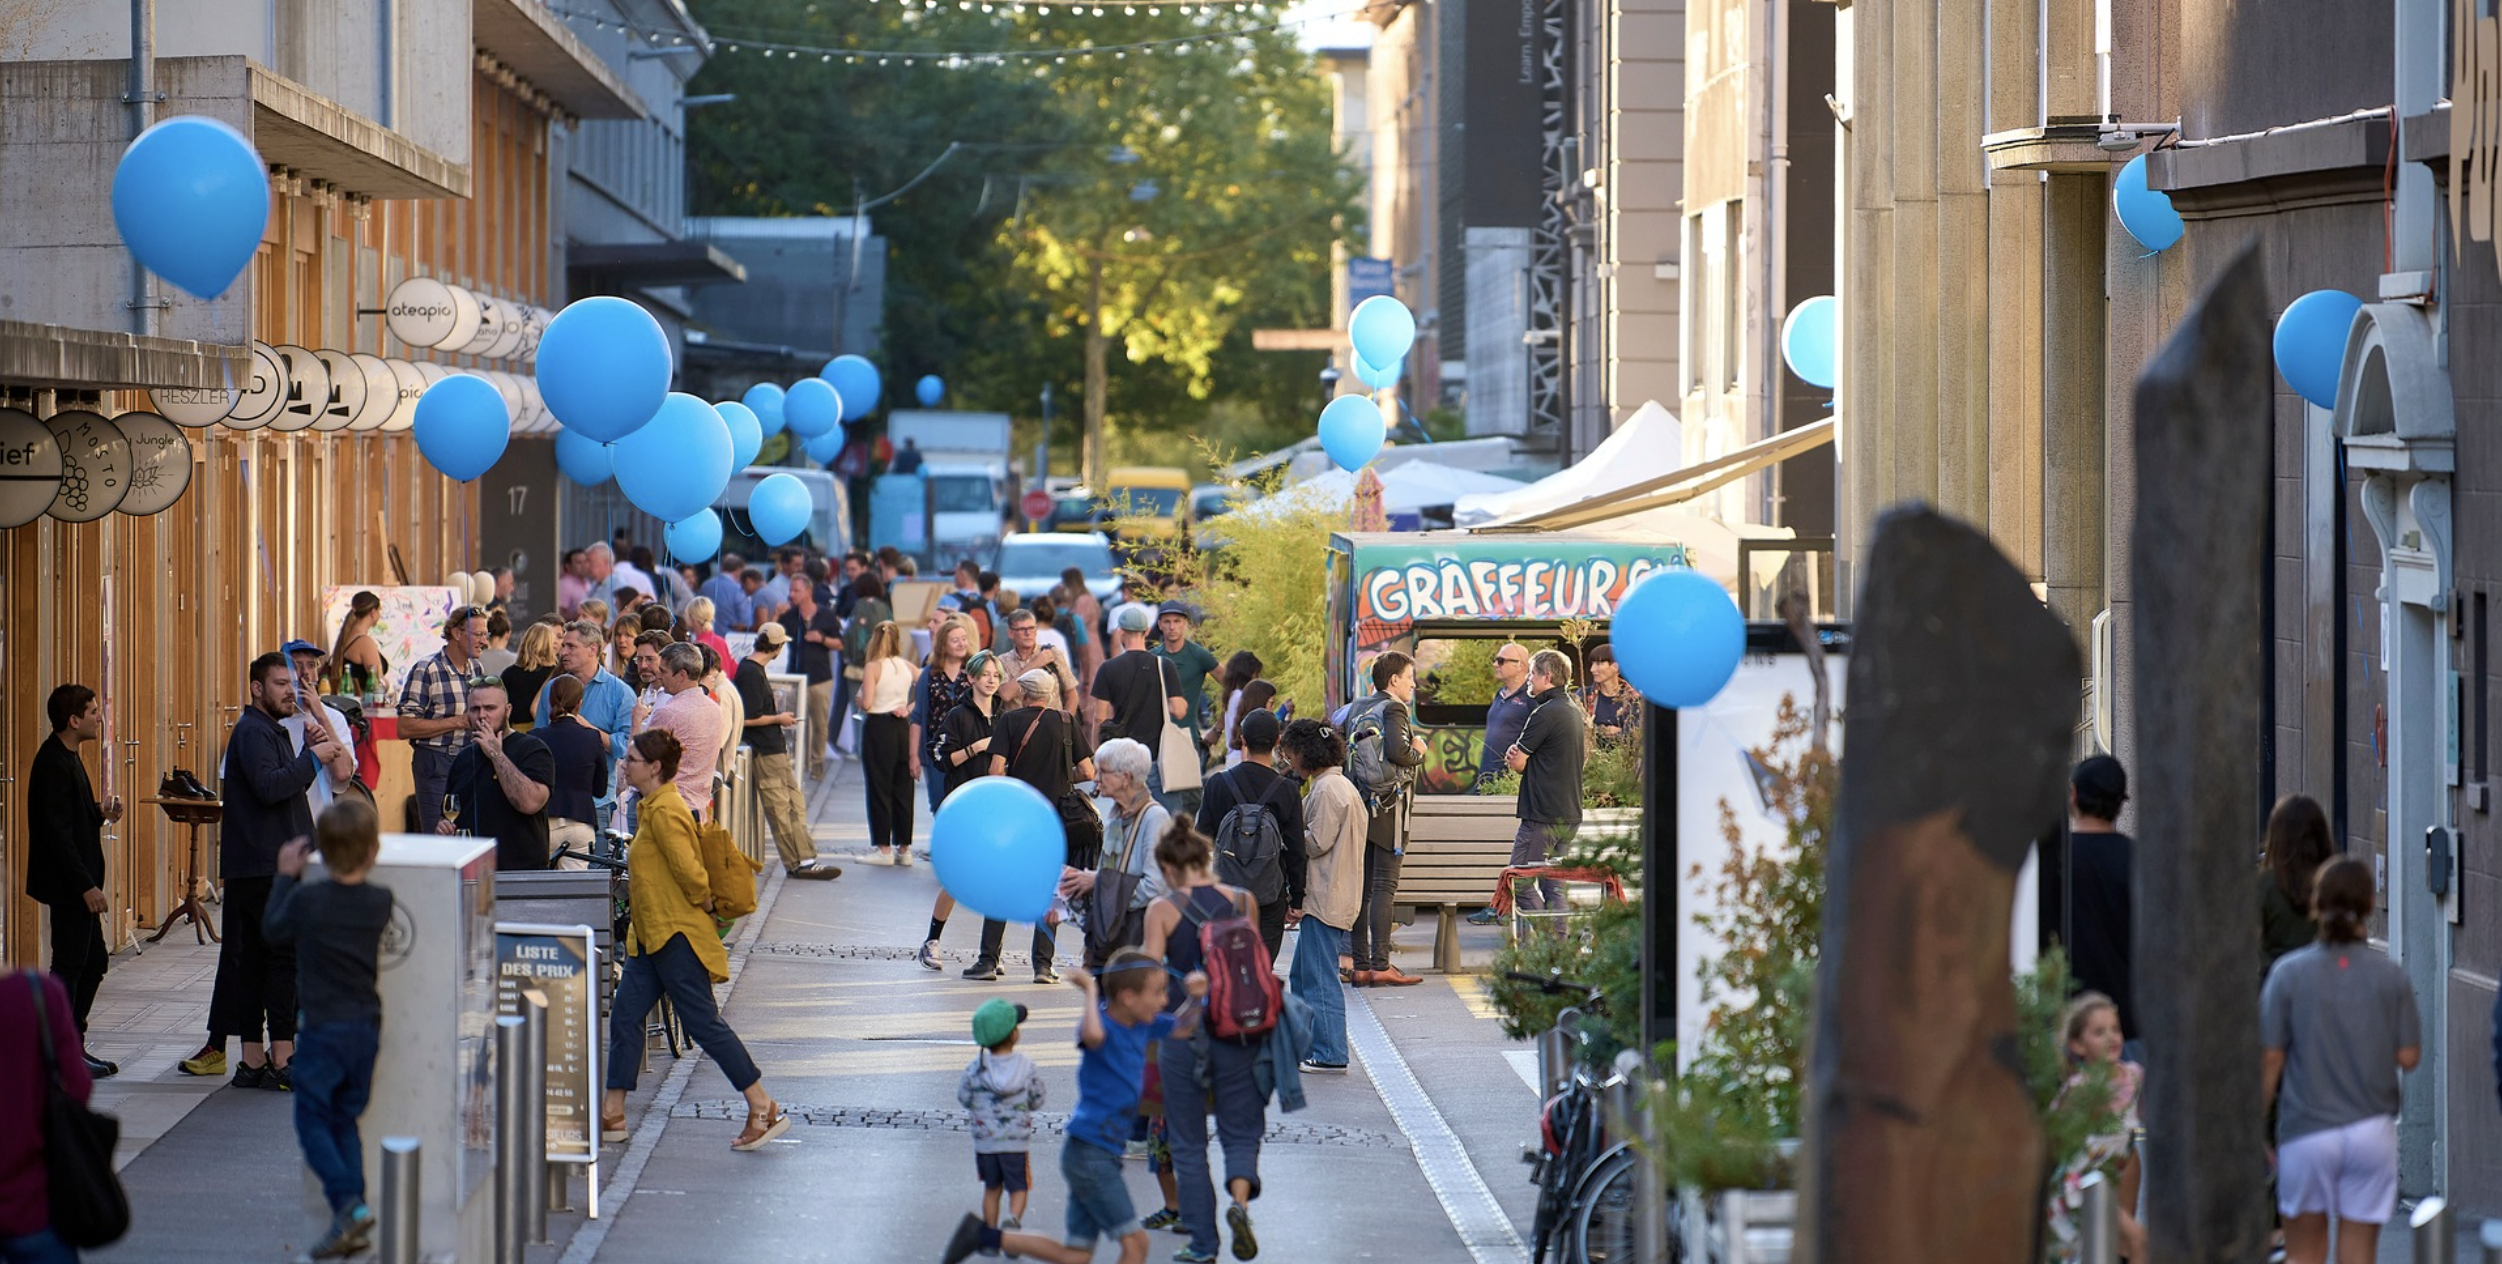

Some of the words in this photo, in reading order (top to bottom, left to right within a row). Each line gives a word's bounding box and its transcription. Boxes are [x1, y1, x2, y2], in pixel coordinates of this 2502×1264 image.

[136, 433, 174, 449] Jungle
[76, 421, 117, 487] MOSTO
[508, 486, 528, 515] 17
[1370, 558, 1617, 621] GRAFFEUR
[516, 944, 558, 960] LISTE
[501, 962, 532, 977] DES
[536, 963, 573, 978] PRIX
